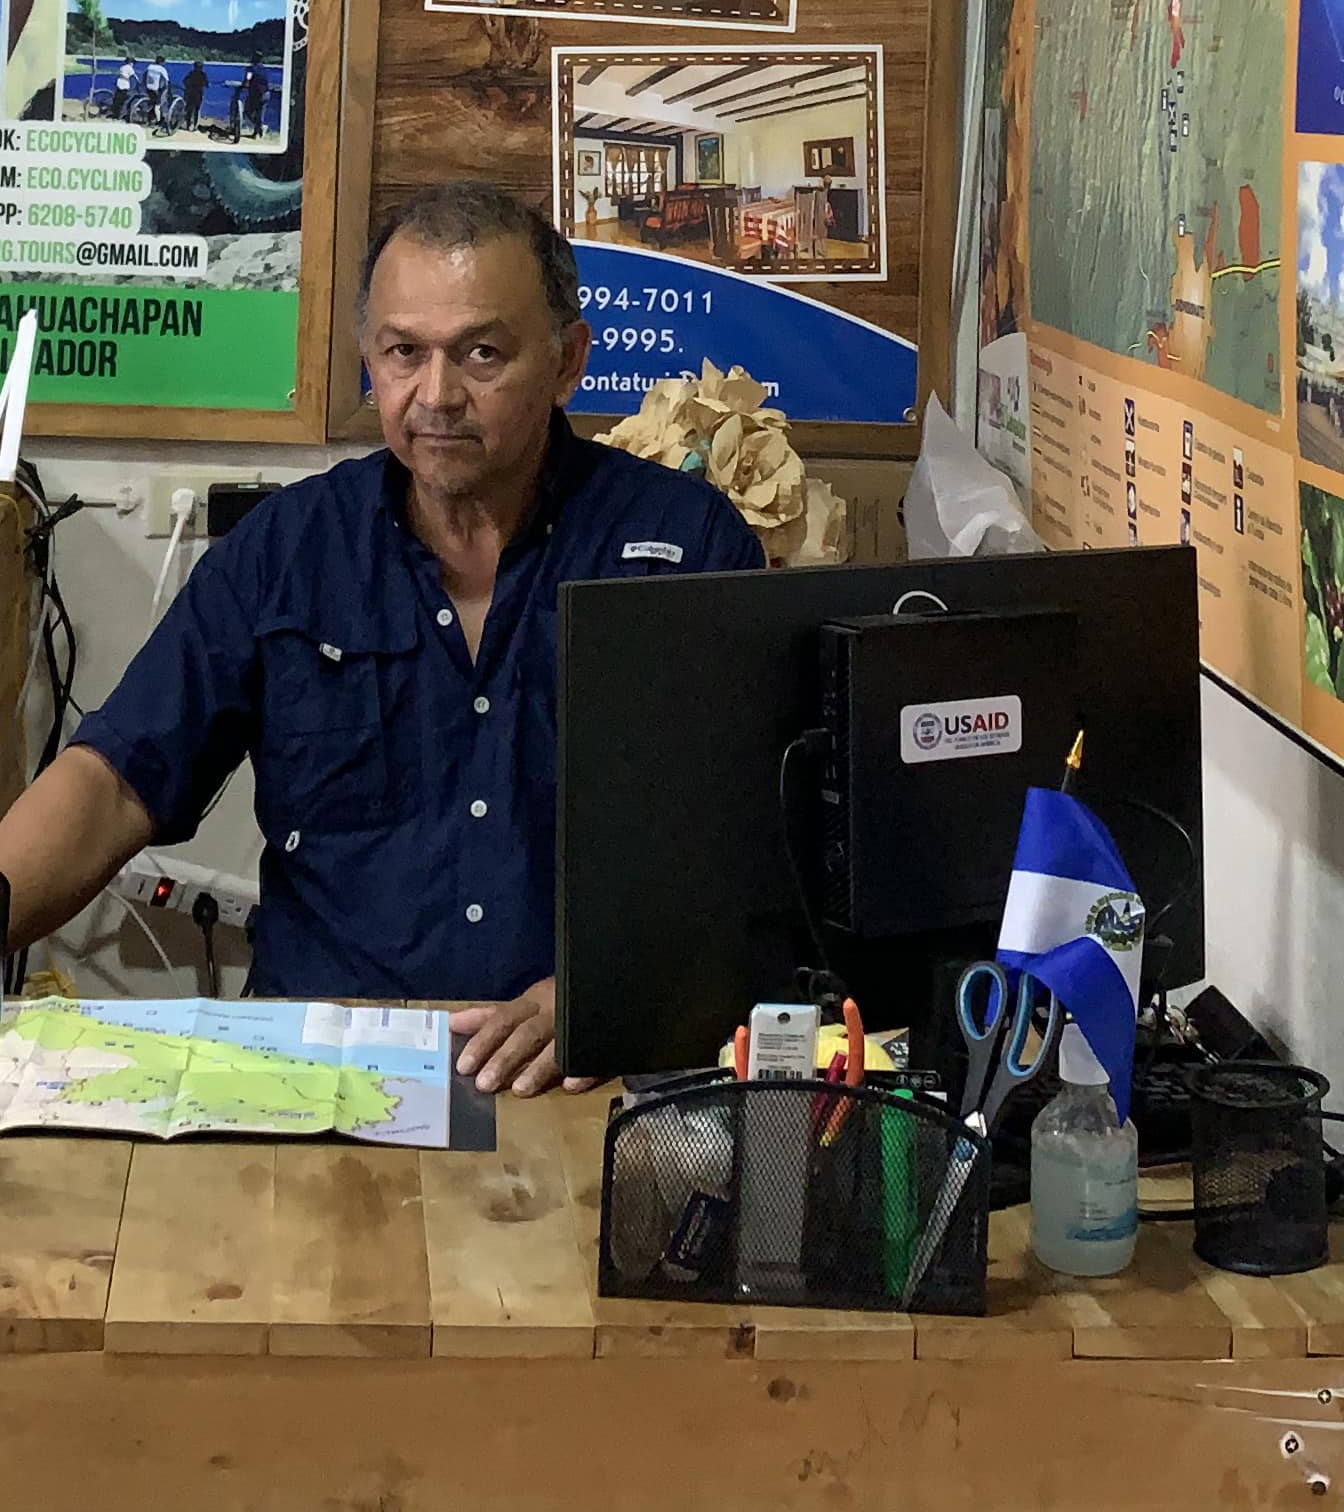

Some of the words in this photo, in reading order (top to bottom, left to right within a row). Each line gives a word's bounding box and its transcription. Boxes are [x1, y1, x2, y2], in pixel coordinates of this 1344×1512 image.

[26, 129, 137, 156] ECOCYCLING
[27, 167, 143, 193] ECO.CYCLING
[28, 205, 132, 229] 6208-5740
[577, 286, 713, 315] 994-7011
[944, 711, 1009, 735] USAID
